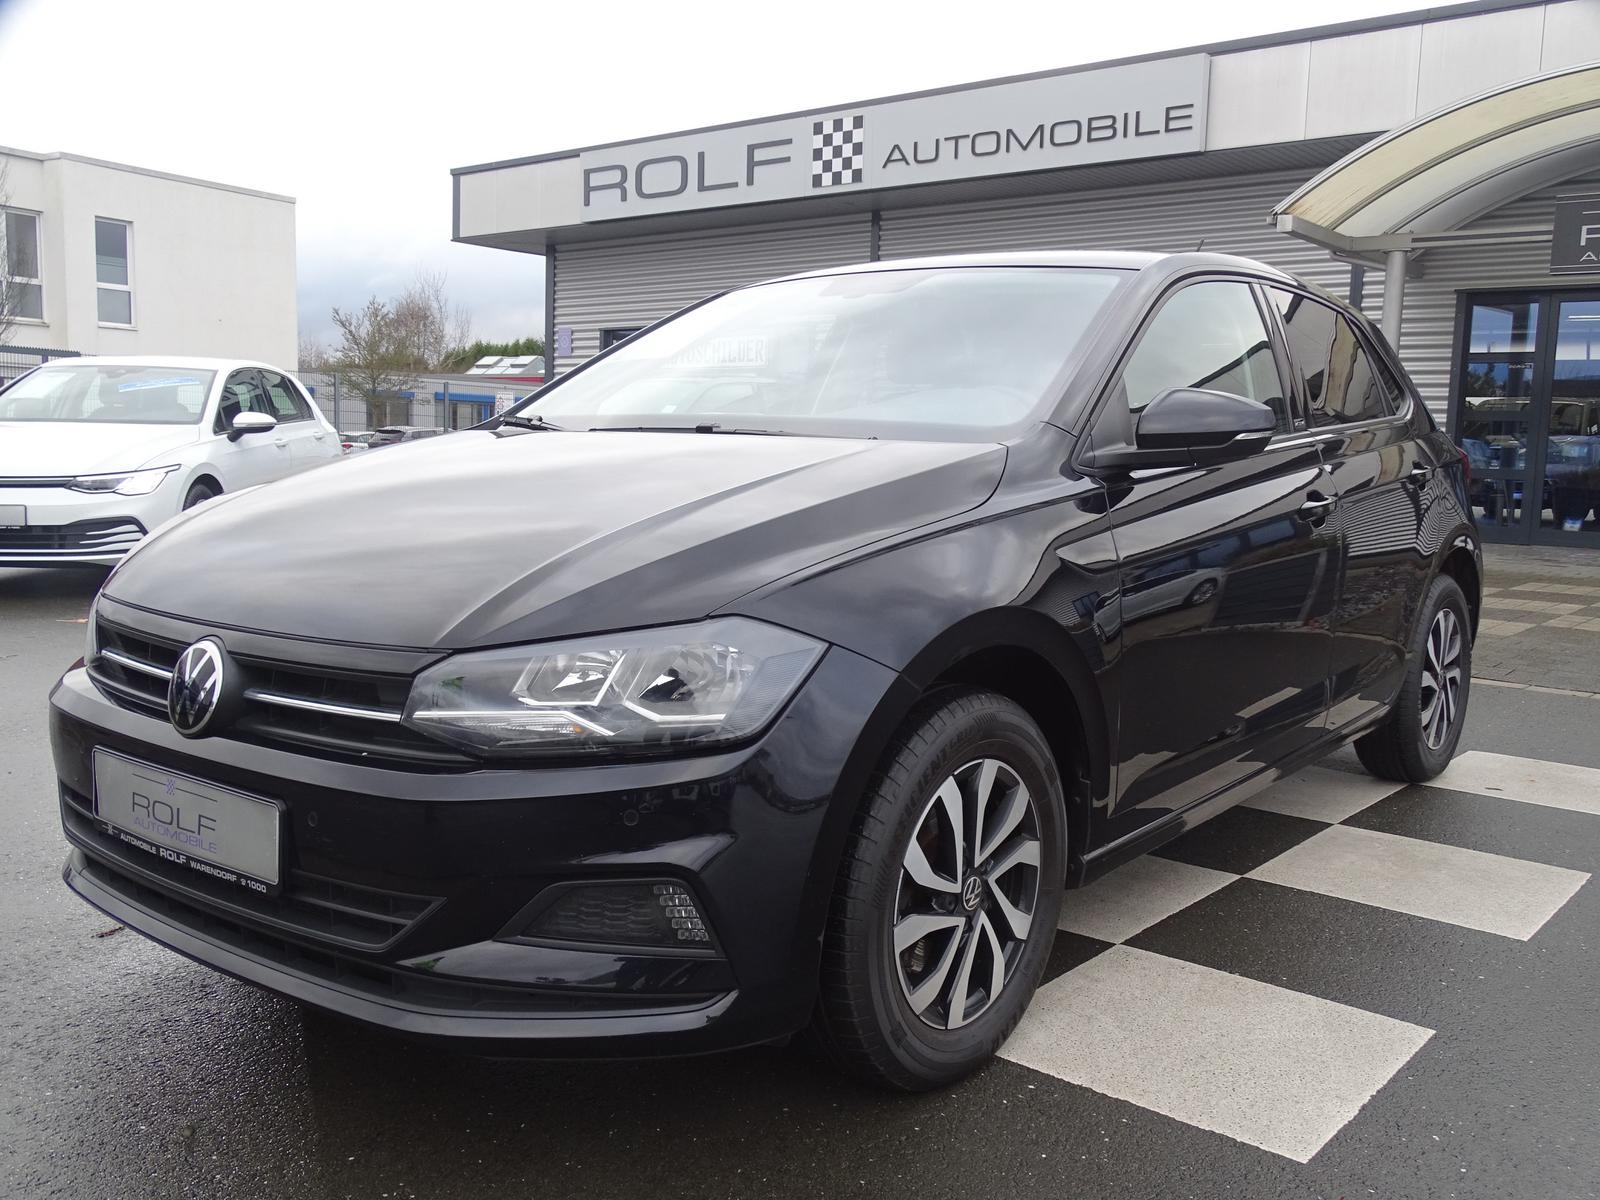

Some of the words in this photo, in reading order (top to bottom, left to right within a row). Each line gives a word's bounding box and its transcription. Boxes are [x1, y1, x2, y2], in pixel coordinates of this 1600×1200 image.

[584, 138, 793, 206] ROLF
[882, 103, 1194, 169] AUTOMOBILE
[132, 791, 217, 836] ROLF
[134, 816, 217, 854] AUTOMOBILE
[120, 833, 157, 855] AUTOMOBILE
[159, 849, 187, 865] ROLF
[189, 860, 237, 883] WARENDORF
